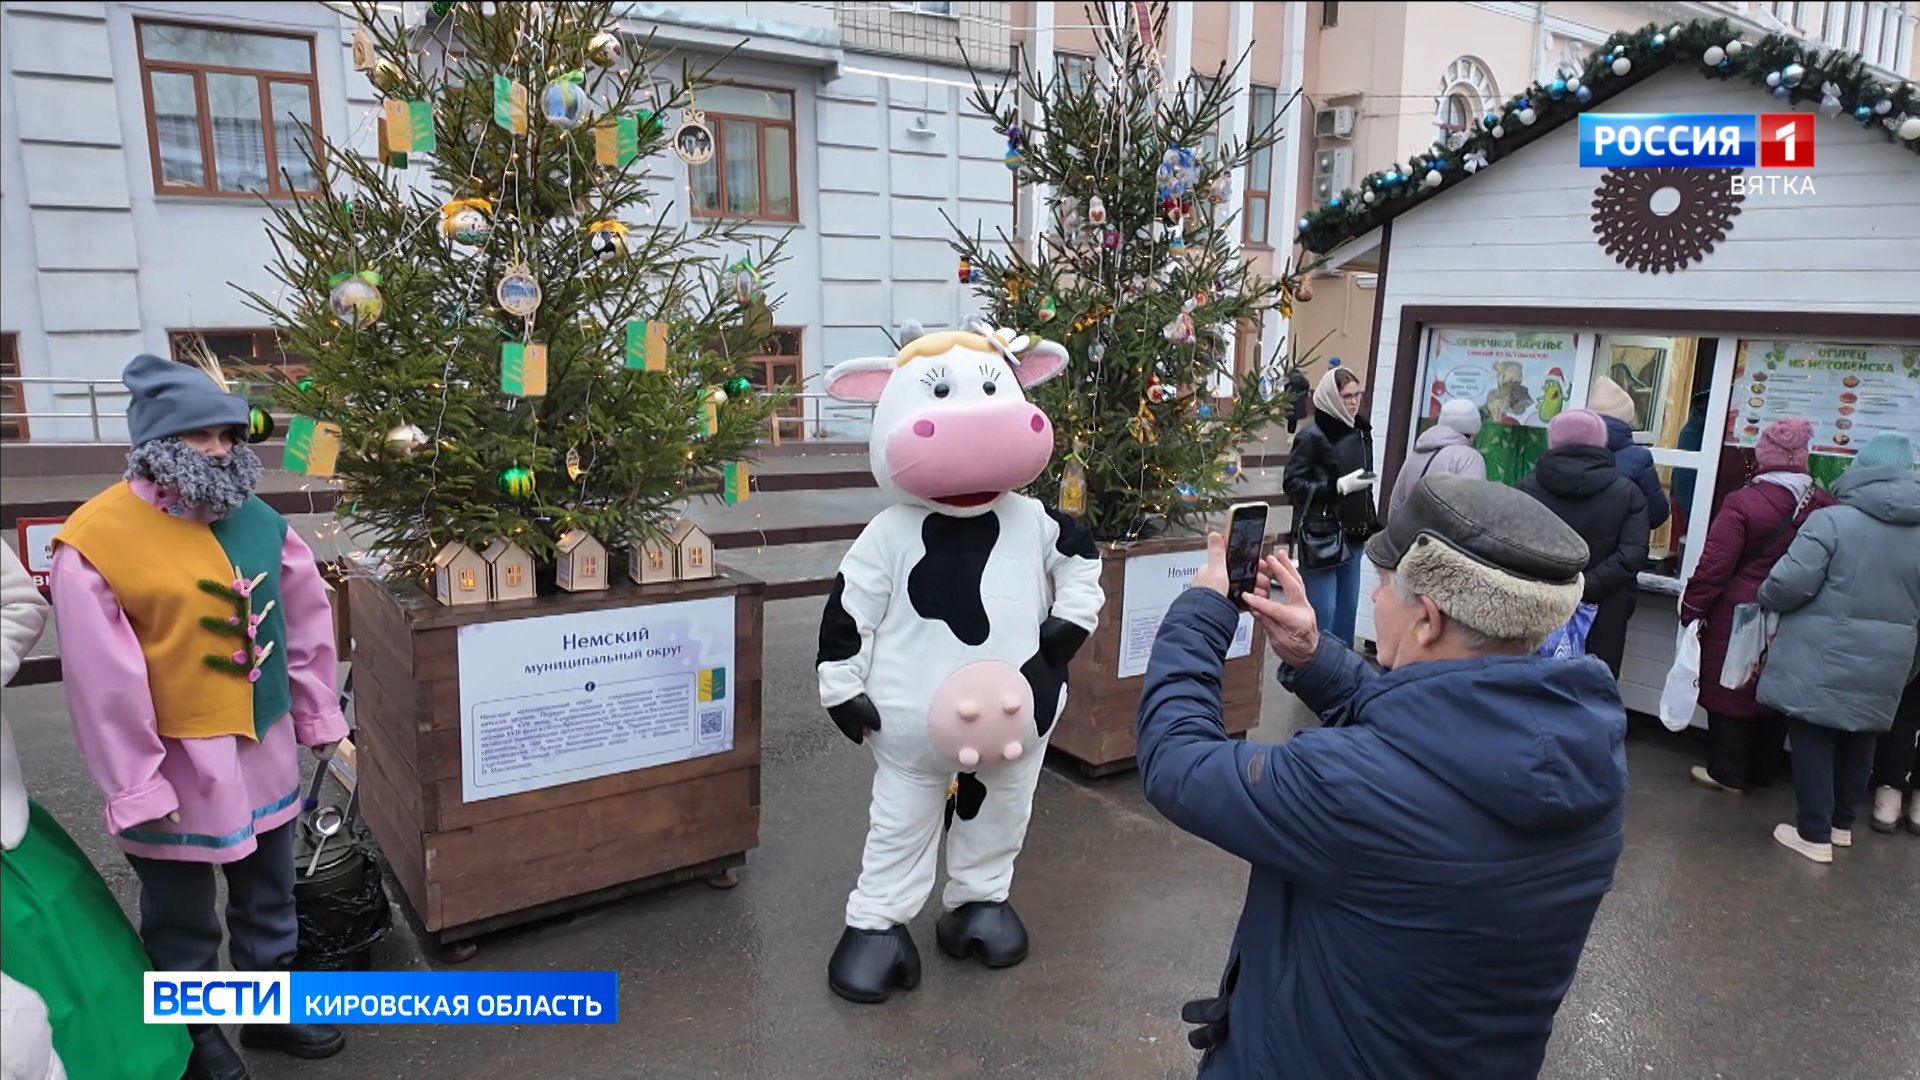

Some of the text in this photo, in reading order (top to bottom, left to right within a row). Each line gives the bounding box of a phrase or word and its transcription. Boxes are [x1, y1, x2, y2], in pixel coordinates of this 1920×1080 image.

[1167, 566, 1199, 578] Нолин
[562, 627, 649, 650] Немский
[524, 644, 684, 676] муниципальный округ
